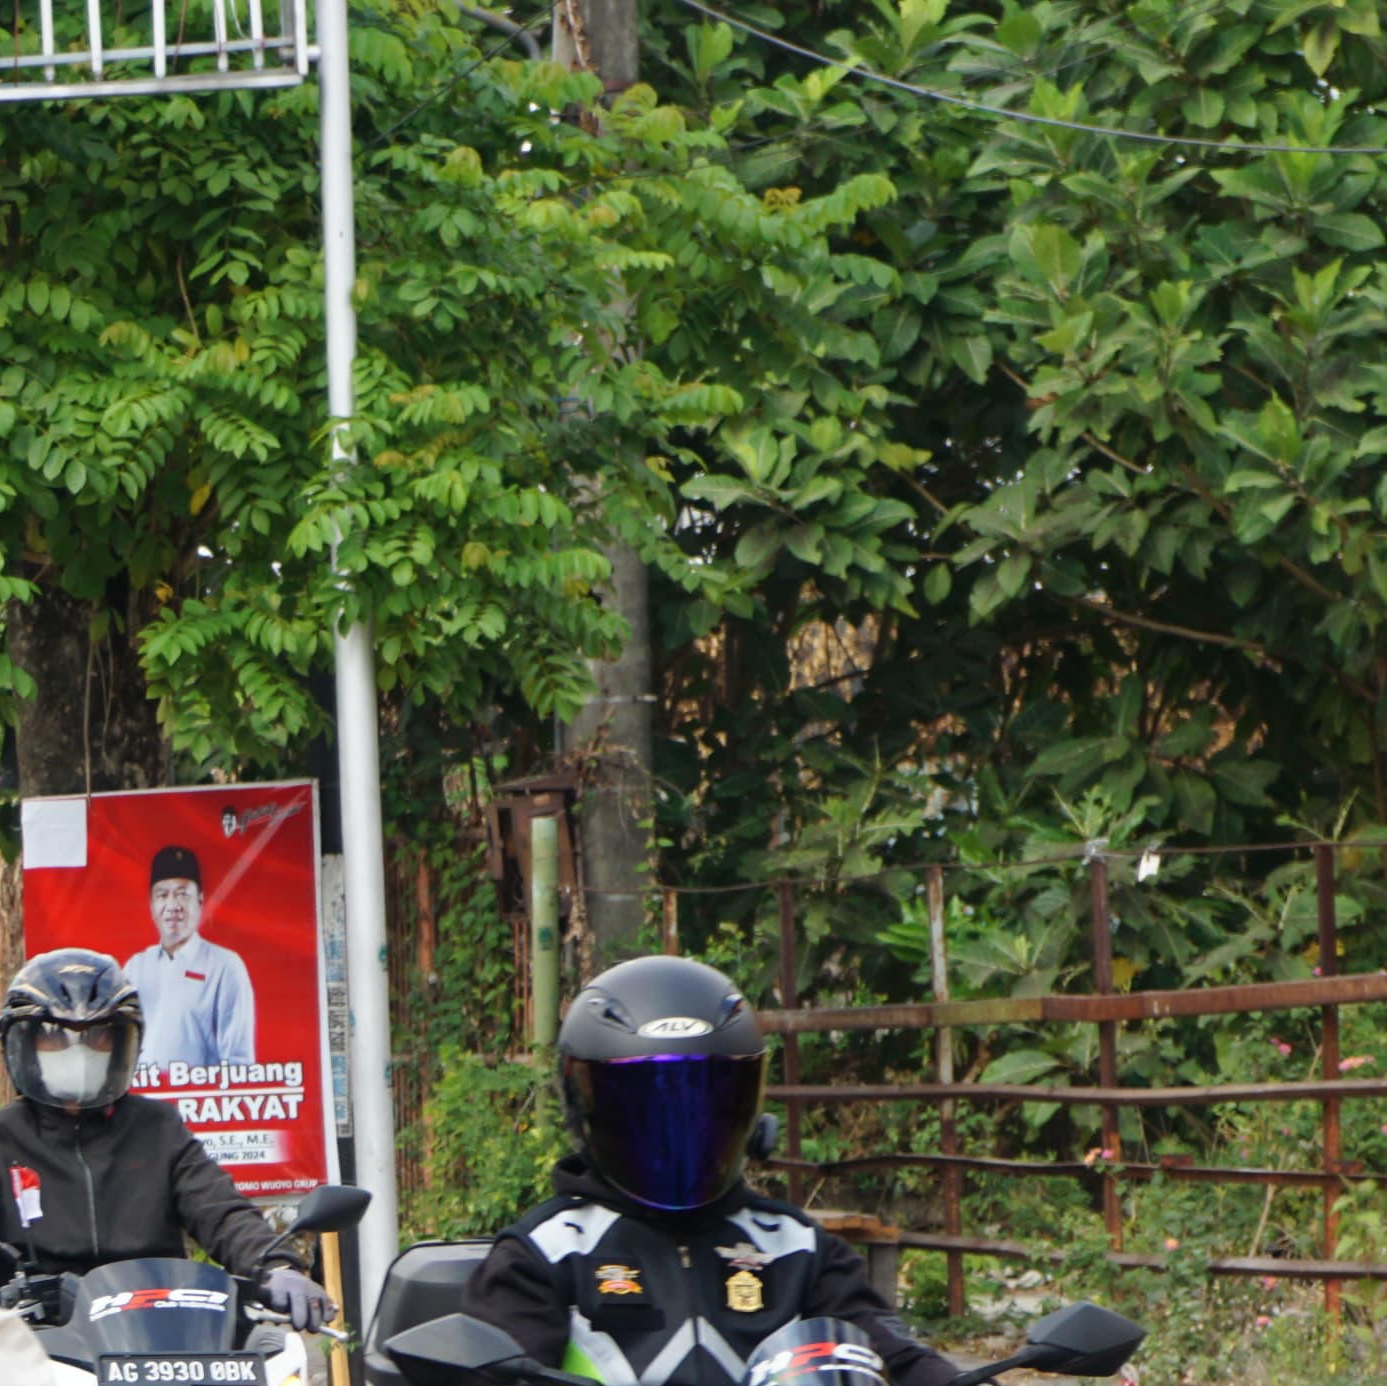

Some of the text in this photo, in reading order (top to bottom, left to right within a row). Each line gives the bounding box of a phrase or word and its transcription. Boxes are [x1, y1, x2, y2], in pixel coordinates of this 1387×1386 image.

[169, 1060, 304, 1090] Berjuang
[177, 1094, 304, 1124] RAKYAT
[246, 1133, 275, 1146] M.E.
[241, 1151, 266, 1160] 2024
[107, 1362, 139, 1383] AG
[143, 1361, 205, 1382] 3930
